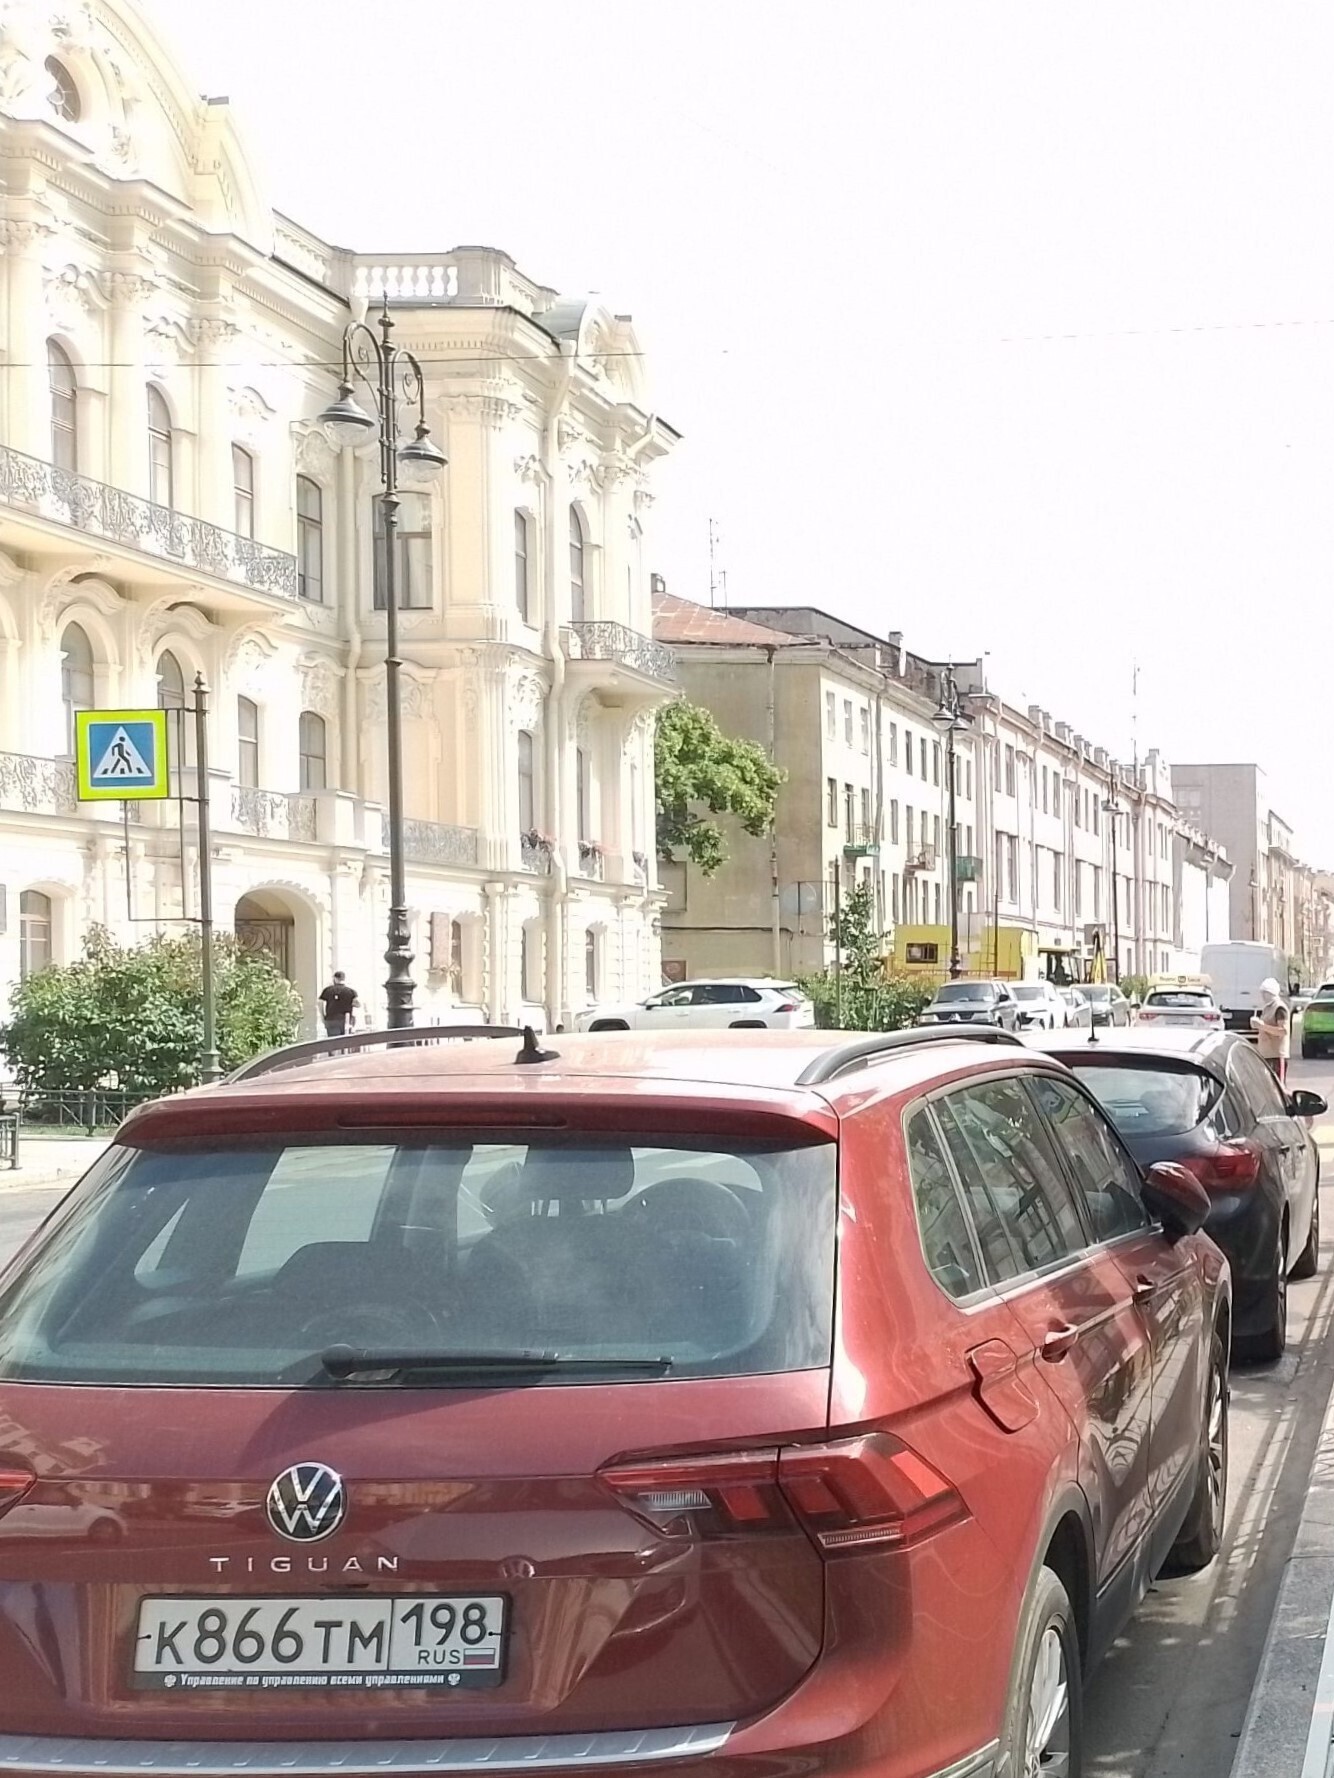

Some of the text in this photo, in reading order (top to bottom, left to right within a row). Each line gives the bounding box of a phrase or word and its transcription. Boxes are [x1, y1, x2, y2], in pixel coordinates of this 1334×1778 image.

[209, 1557, 400, 1572] TIGUAN
[400, 1603, 488, 1646] 198
[154, 1607, 384, 1665] К866ТМ
[417, 1649, 461, 1665] RUS
[180, 1673, 444, 1687] Управление по управлению всеми управлениями
